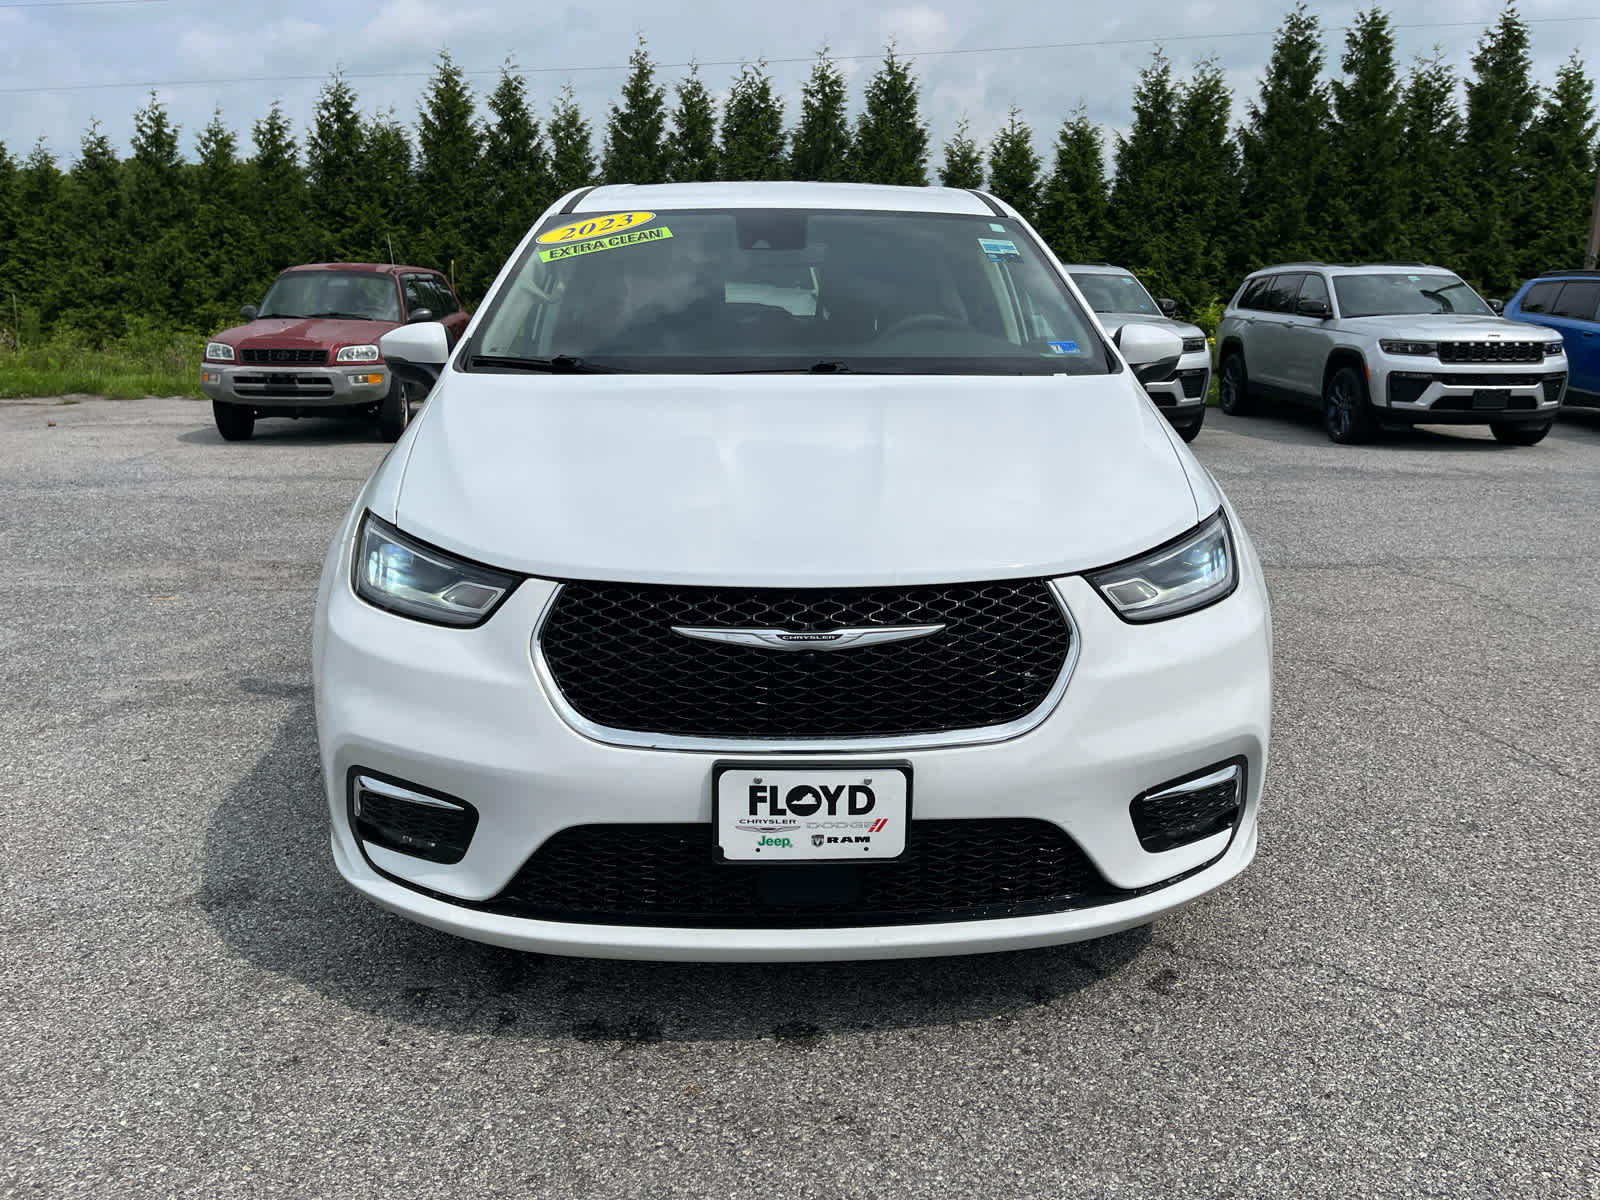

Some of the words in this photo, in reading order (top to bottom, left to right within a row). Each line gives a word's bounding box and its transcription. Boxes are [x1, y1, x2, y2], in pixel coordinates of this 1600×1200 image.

[560, 214, 633, 240] 2023
[550, 240, 605, 259] EXTRA
[608, 229, 661, 246] CLEAN
[749, 784, 876, 816] FLOYD
[826, 836, 870, 844] RAM
